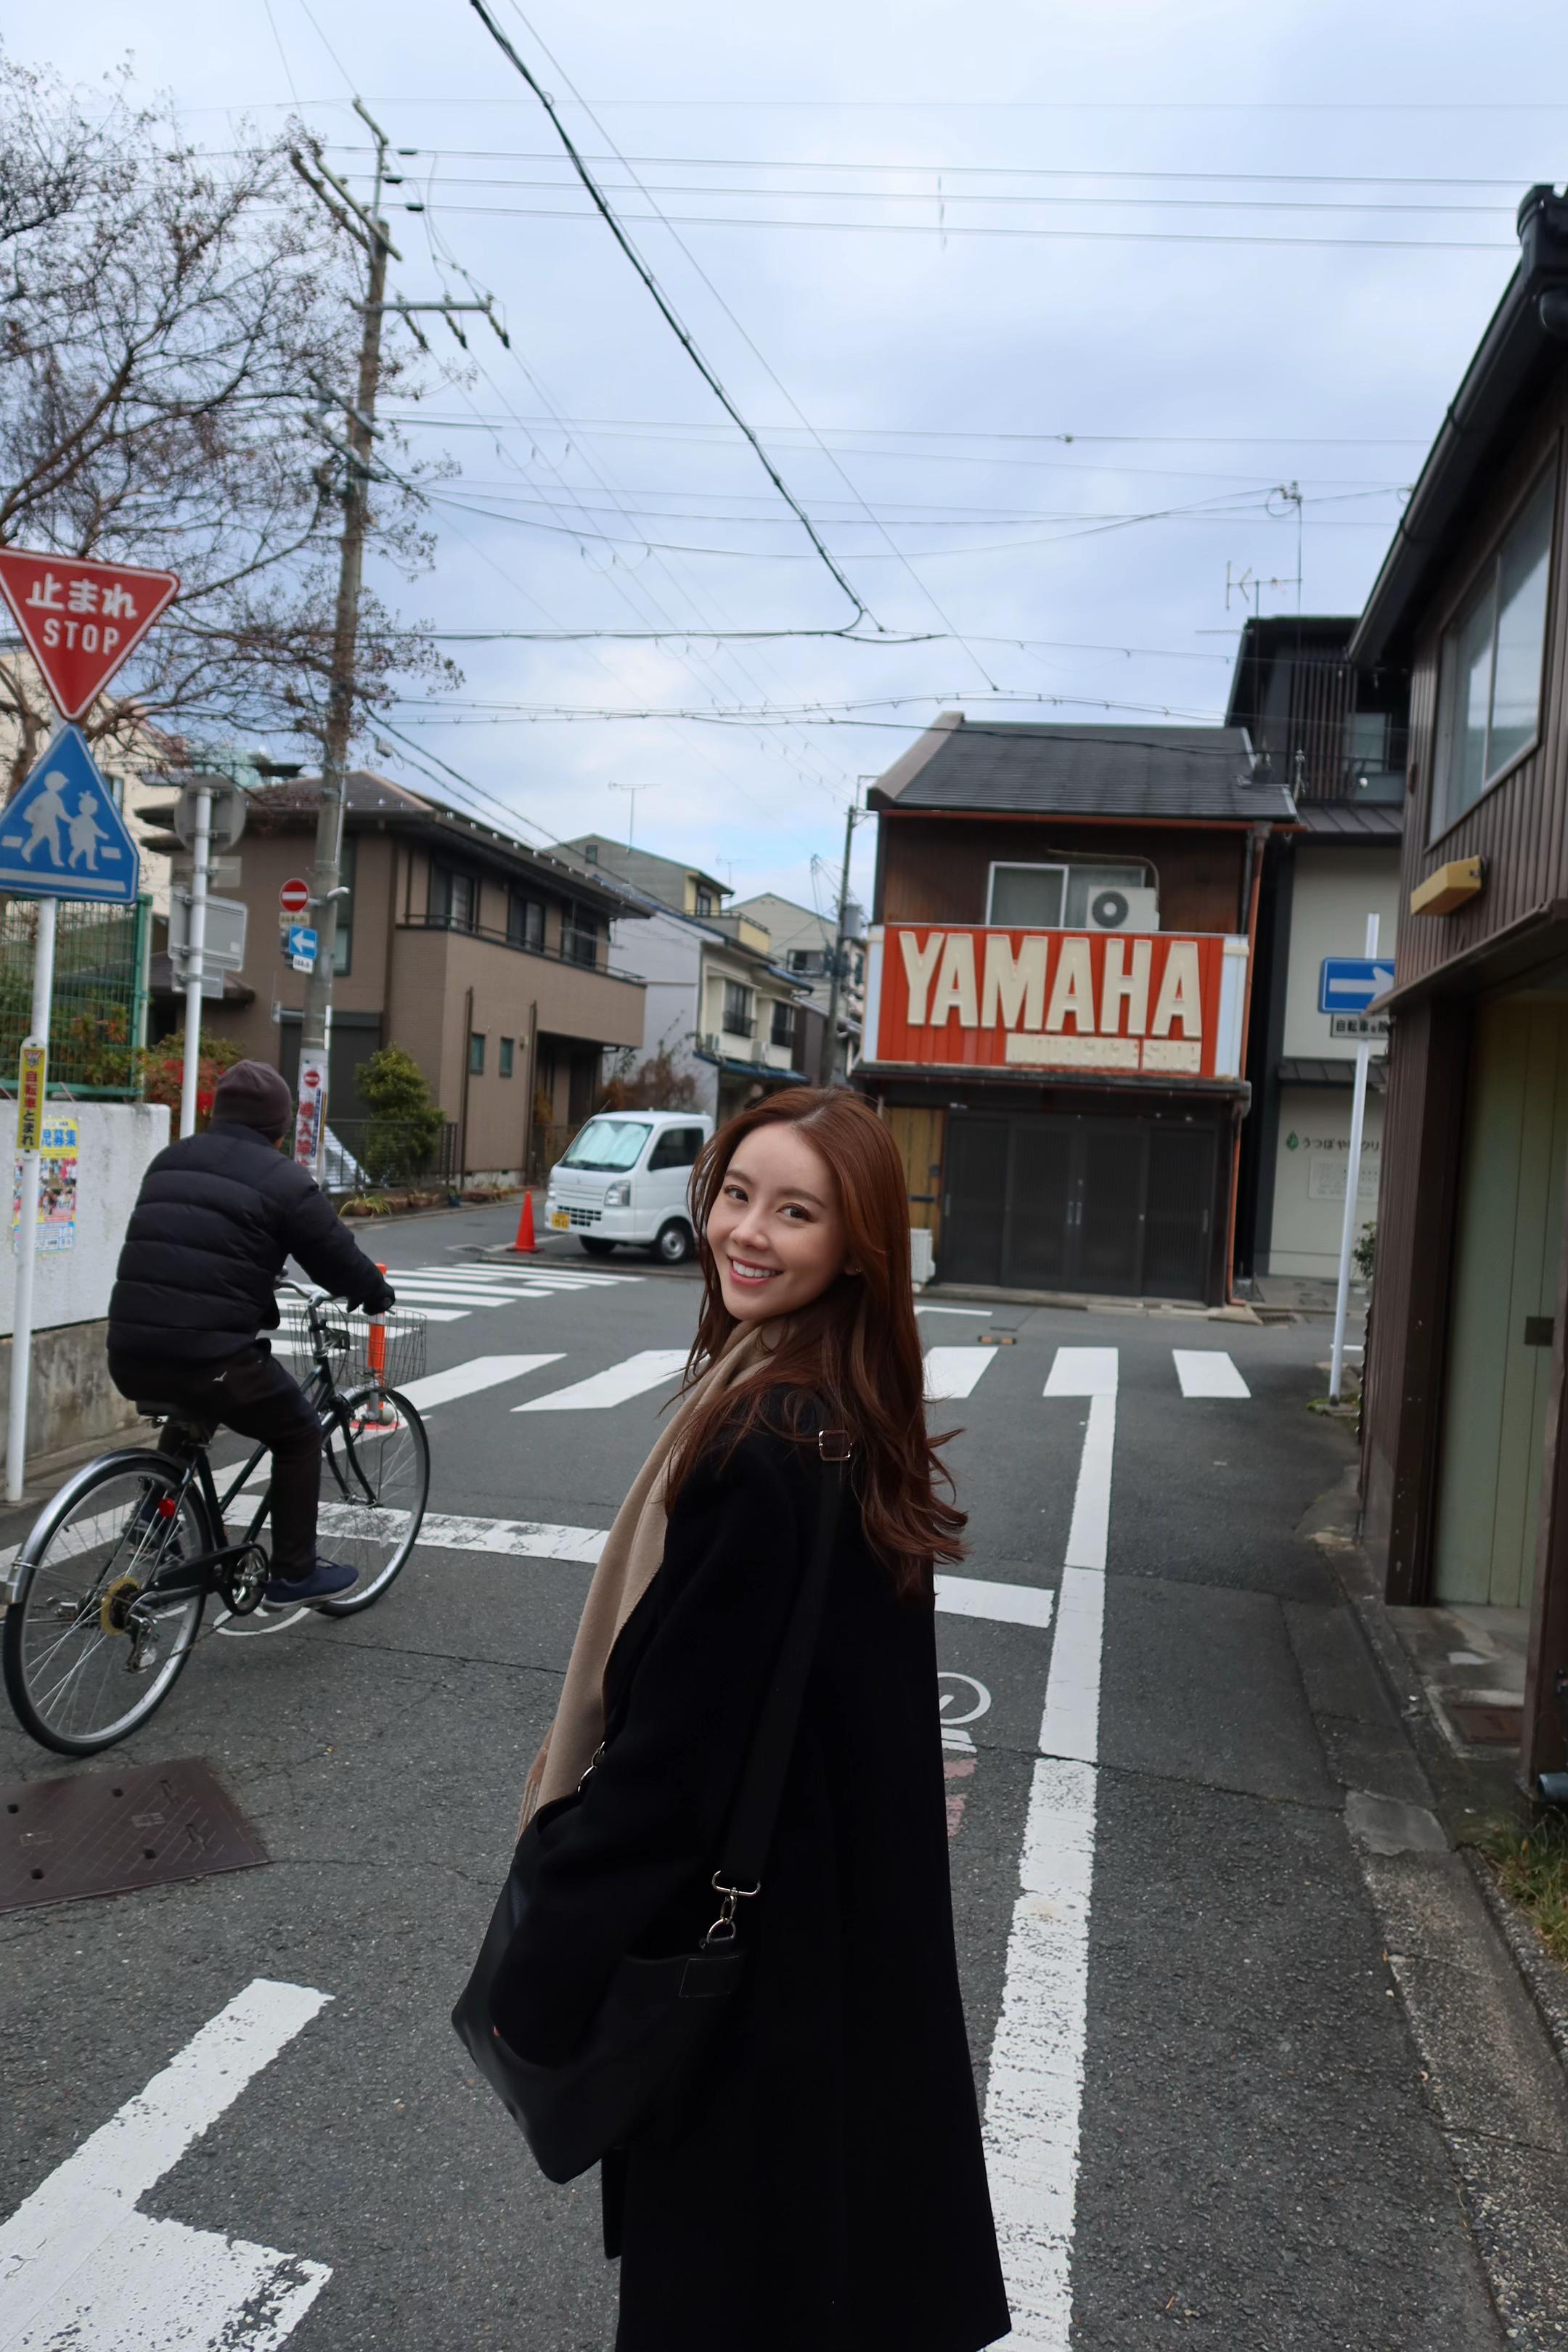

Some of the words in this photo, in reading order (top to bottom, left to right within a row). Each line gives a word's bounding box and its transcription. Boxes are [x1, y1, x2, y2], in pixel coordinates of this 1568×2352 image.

[25, 572, 138, 618] 止まれ
[42, 617, 120, 656] STOP
[899, 931, 1202, 1037] YAMAHA
[22, 1071, 38, 1146] 自転車とまれ
